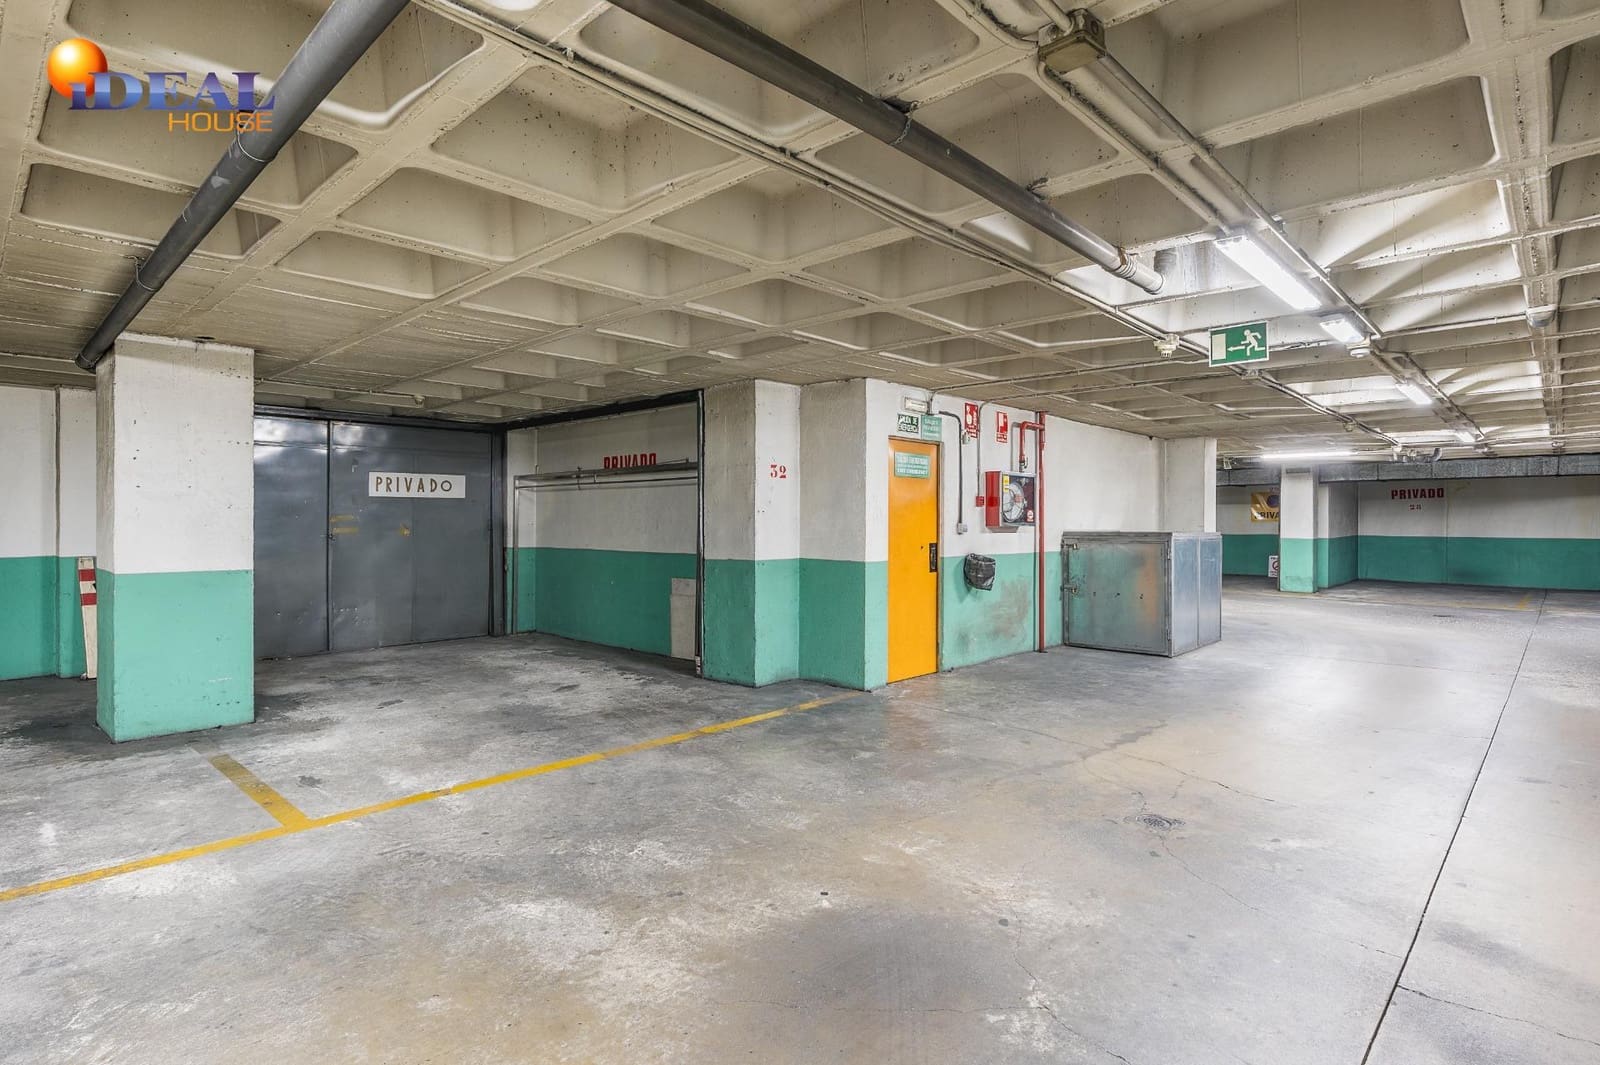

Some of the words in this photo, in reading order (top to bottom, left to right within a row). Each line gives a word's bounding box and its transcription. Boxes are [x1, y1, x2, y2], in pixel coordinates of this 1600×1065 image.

[603, 452, 657, 469] PRIVADO
[770, 464, 787, 479] 32
[375, 476, 453, 493] PRIVADO
[1391, 487, 1445, 500] PRIVADO
